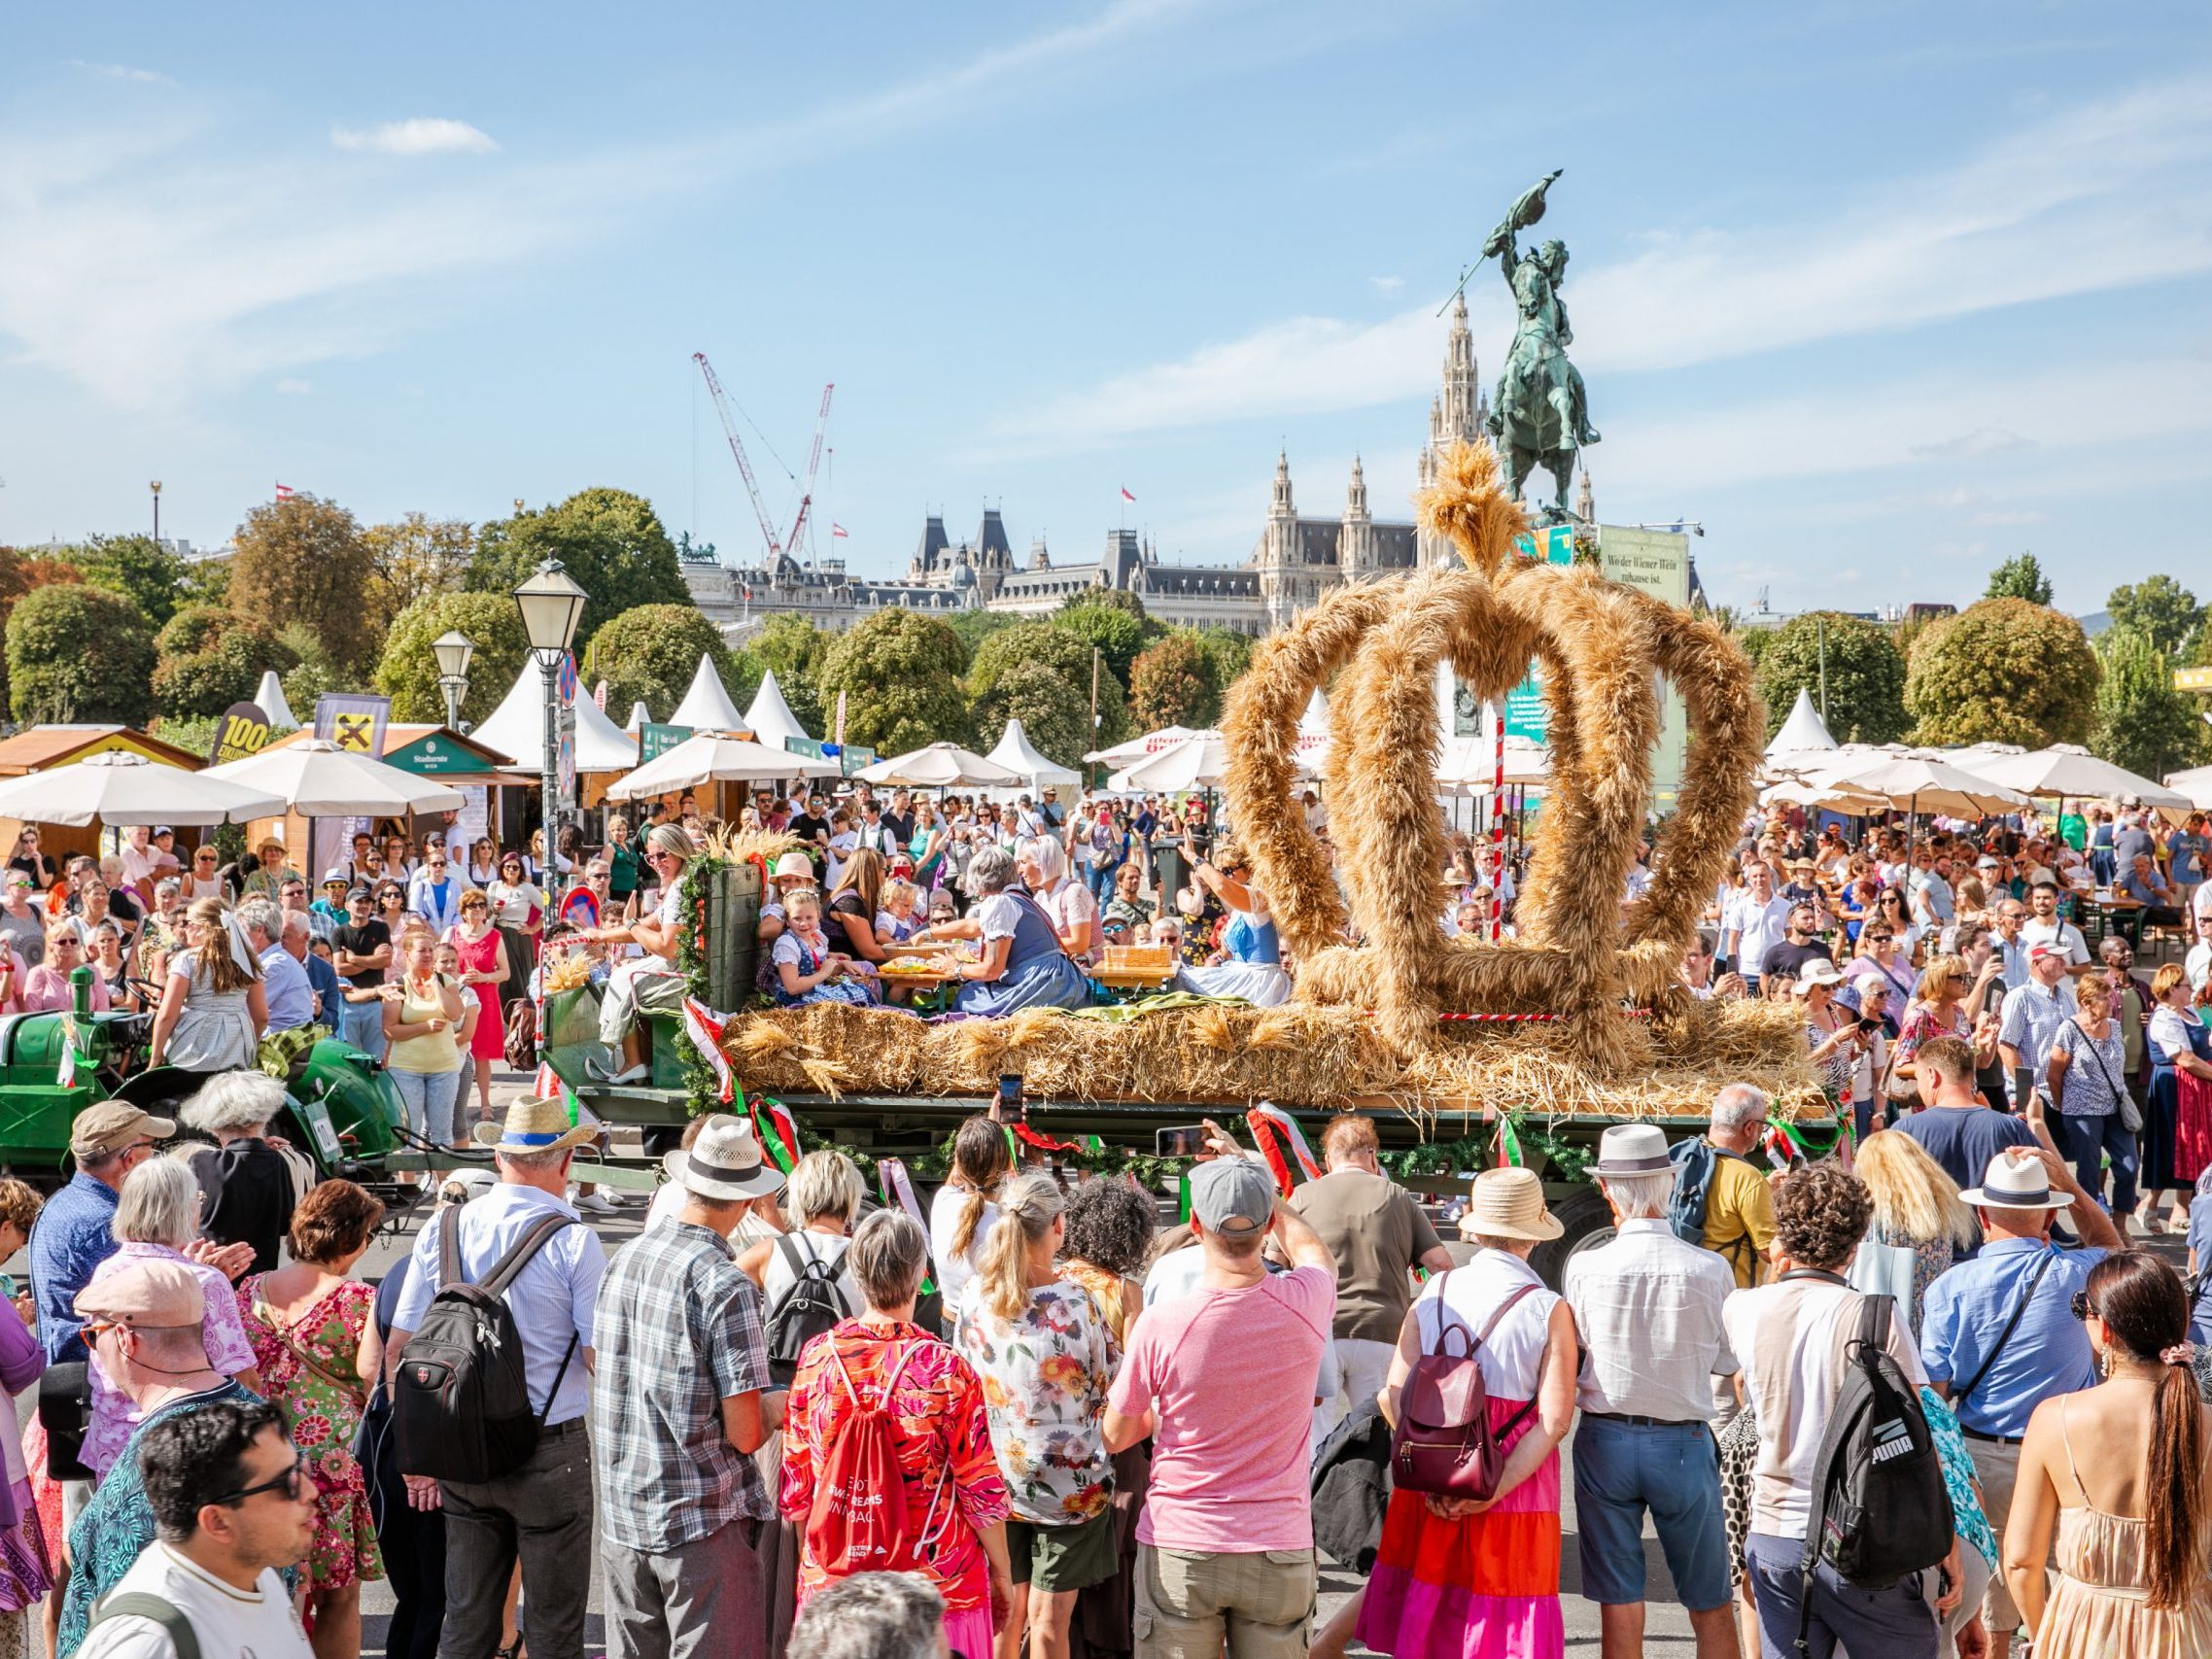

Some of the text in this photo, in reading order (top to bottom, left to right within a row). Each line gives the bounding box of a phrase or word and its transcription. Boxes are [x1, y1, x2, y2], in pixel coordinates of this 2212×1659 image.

[1607, 555, 1676, 570] Wo der Wiener Wein
[1621, 572, 1649, 583] zuhause
[223, 715, 268, 751] 100
[1872, 1435, 1914, 1465] PUMA
